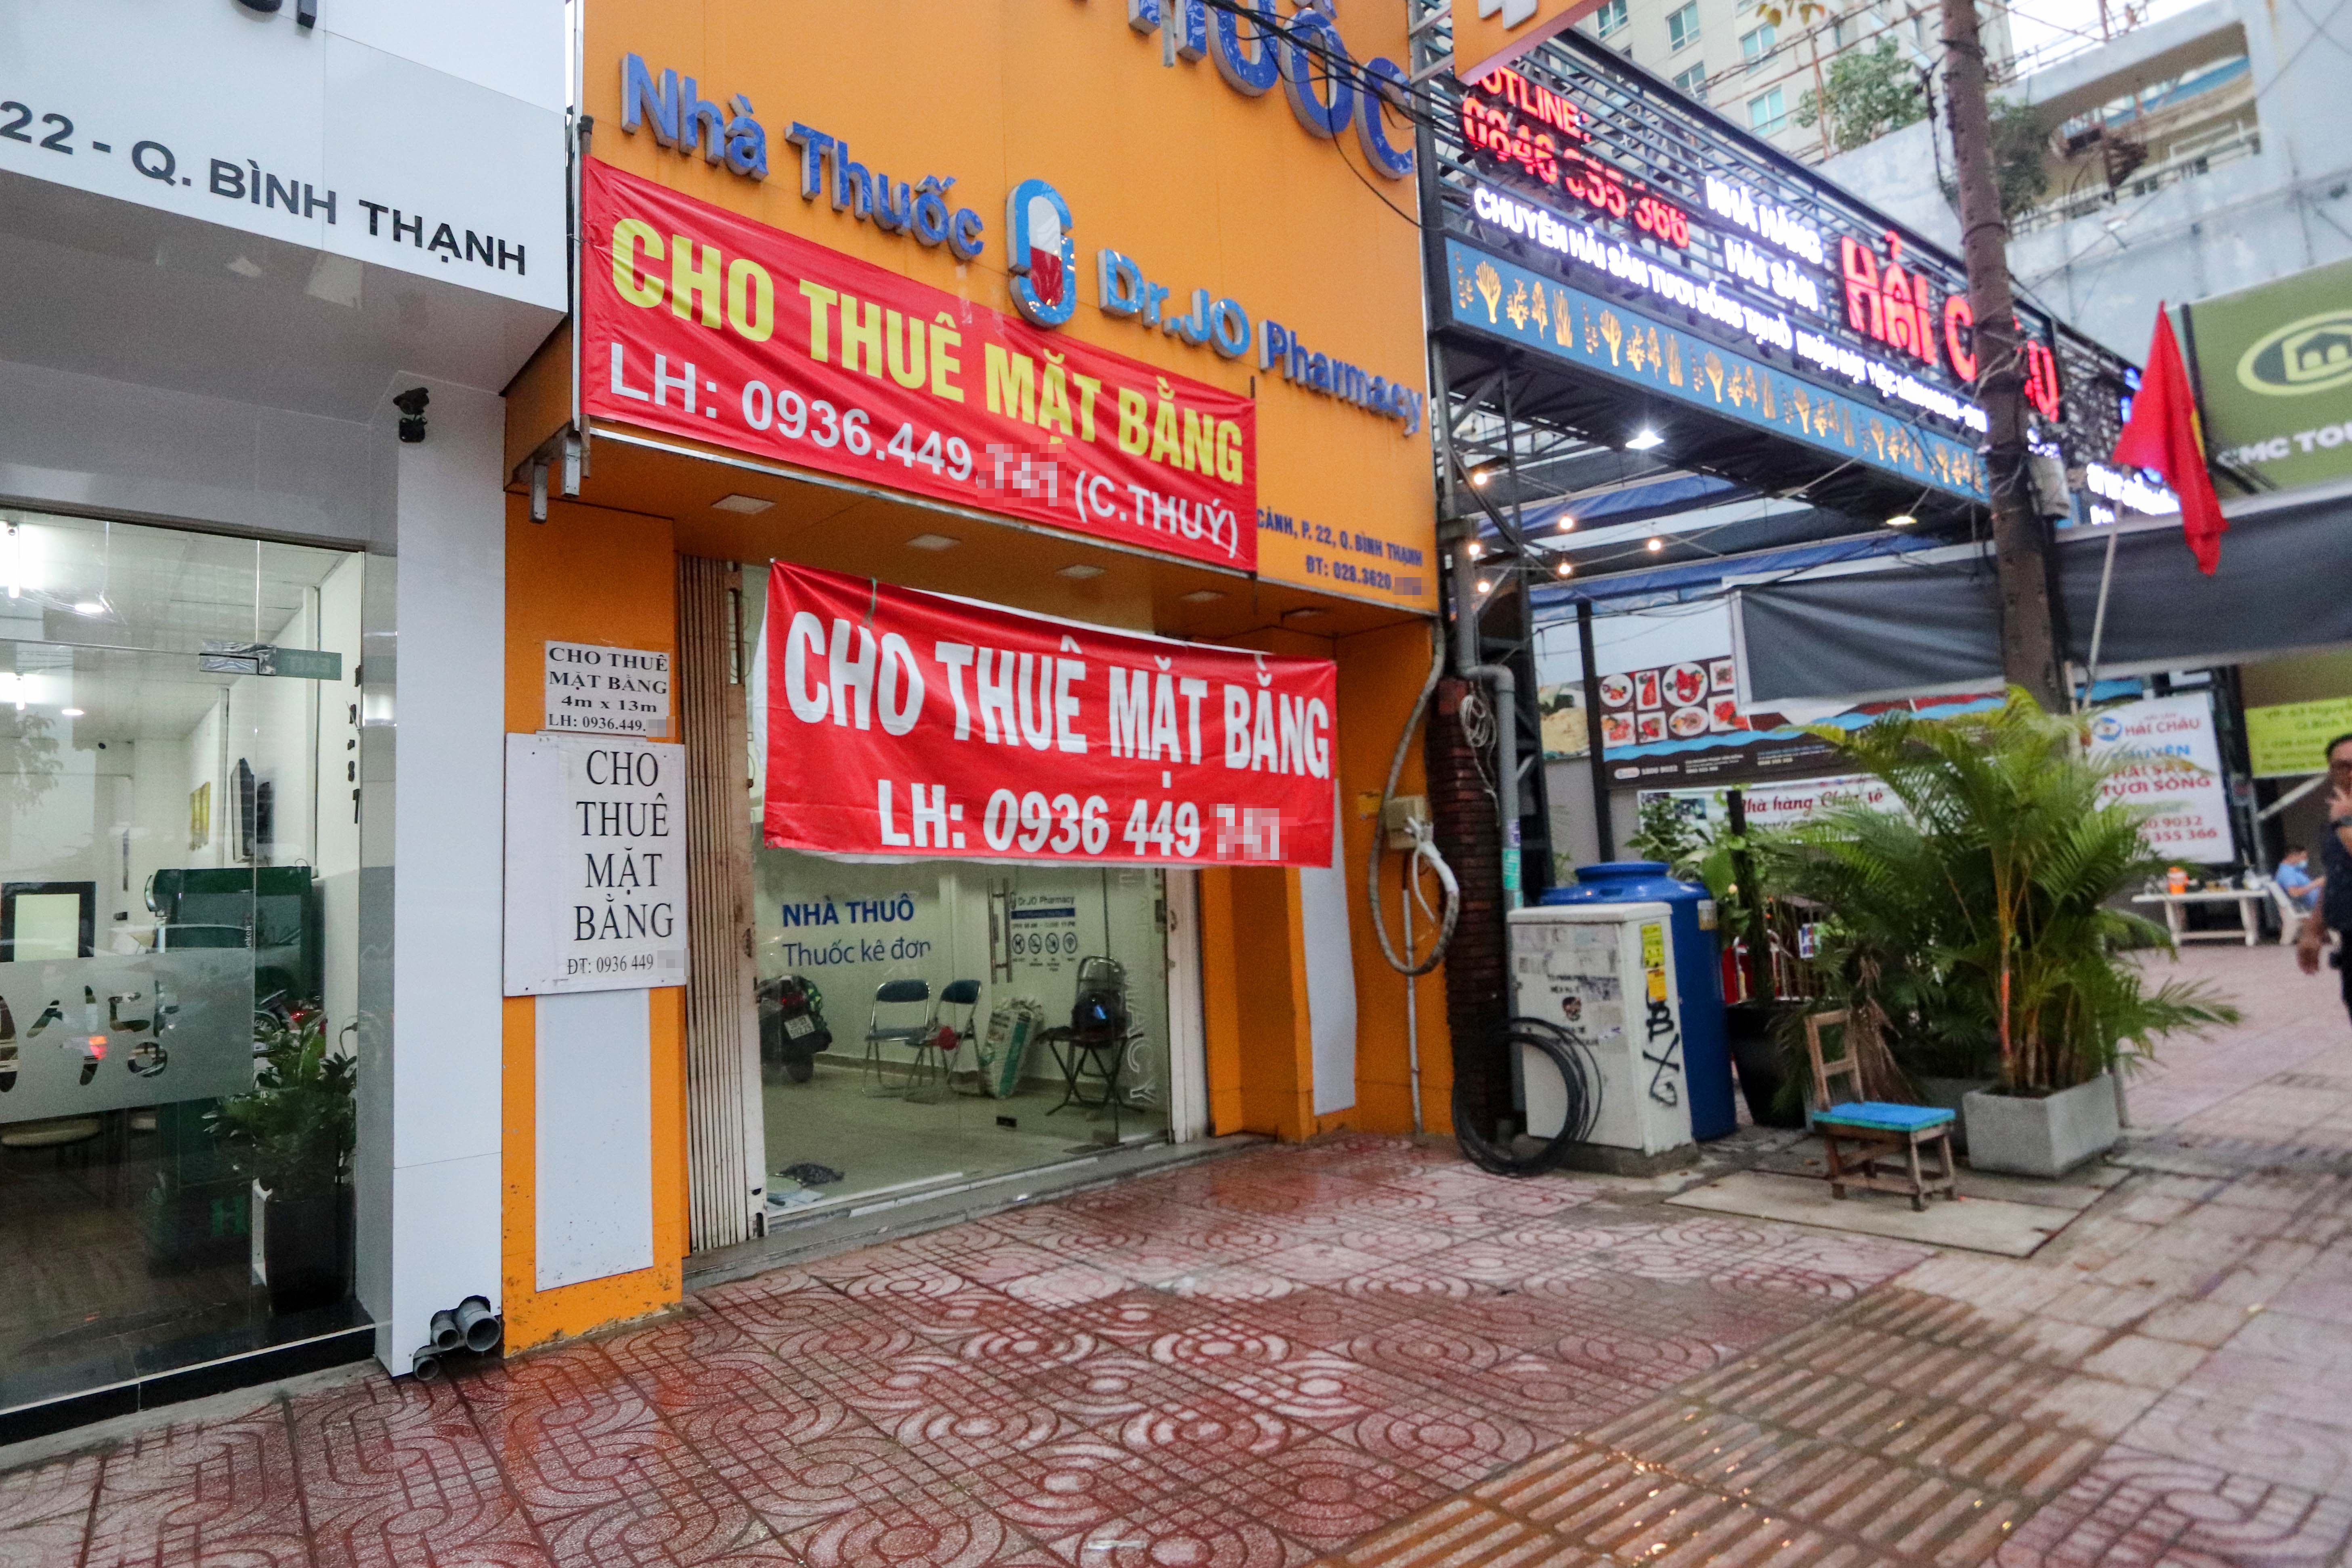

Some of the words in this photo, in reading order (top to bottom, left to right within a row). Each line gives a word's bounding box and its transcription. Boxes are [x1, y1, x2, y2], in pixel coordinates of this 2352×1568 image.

[1476, 64, 1591, 144] OTLINE:
[621, 52, 768, 182] Nhà
[785, 121, 985, 260] Thuốc
[131, 140, 191, 186] Q.
[209, 158, 337, 224] BÌNH
[359, 199, 526, 275] THẠNH
[1841, 229, 1937, 365] HẢI
[612, 218, 774, 342] CHO
[799, 279, 964, 402] THUÊ
[984, 342, 1102, 443] MẶT
[1118, 375, 1244, 484] BẰNG
[1097, 248, 1251, 358] Dr.JO
[1258, 320, 1423, 437] Pharmacy
[611, 342, 716, 419] LH:
[741, 381, 1058, 507] 0936.449.
[1301, 520, 1312, 540] P.
[549, 648, 601, 665] CHO
[607, 654, 667, 671] THUÊ
[549, 671, 601, 690] MẶT
[607, 674, 667, 694] BẰNG
[548, 713, 577, 727] LH:
[582, 716, 667, 733] 0936.449.
[561, 695, 592, 708] 4m
[600, 701, 610, 709] x
[617, 700, 657, 713] 13m
[785, 611, 925, 736] CHO
[935, 635, 1088, 754] THUÊ
[1109, 655, 1208, 788] MẶT
[1223, 653, 1330, 780] BẰNG
[587, 750, 659, 786] CHO
[576, 792, 669, 837] THUÊ
[877, 779, 966, 849] LH:
[983, 788, 1110, 855] 0936
[1122, 799, 1201, 857] 449
[585, 847, 662, 895] MẶT
[573, 893, 674, 941] BẰNG
[783, 894, 839, 927] NHÀ
[567, 957, 592, 975] ĐT:
[596, 956, 627, 973] 0936
[632, 954, 654, 971] 449
[782, 938, 855, 967] Thuốc
[860, 938, 885, 962] kê
[891, 936, 931, 960] đơn
